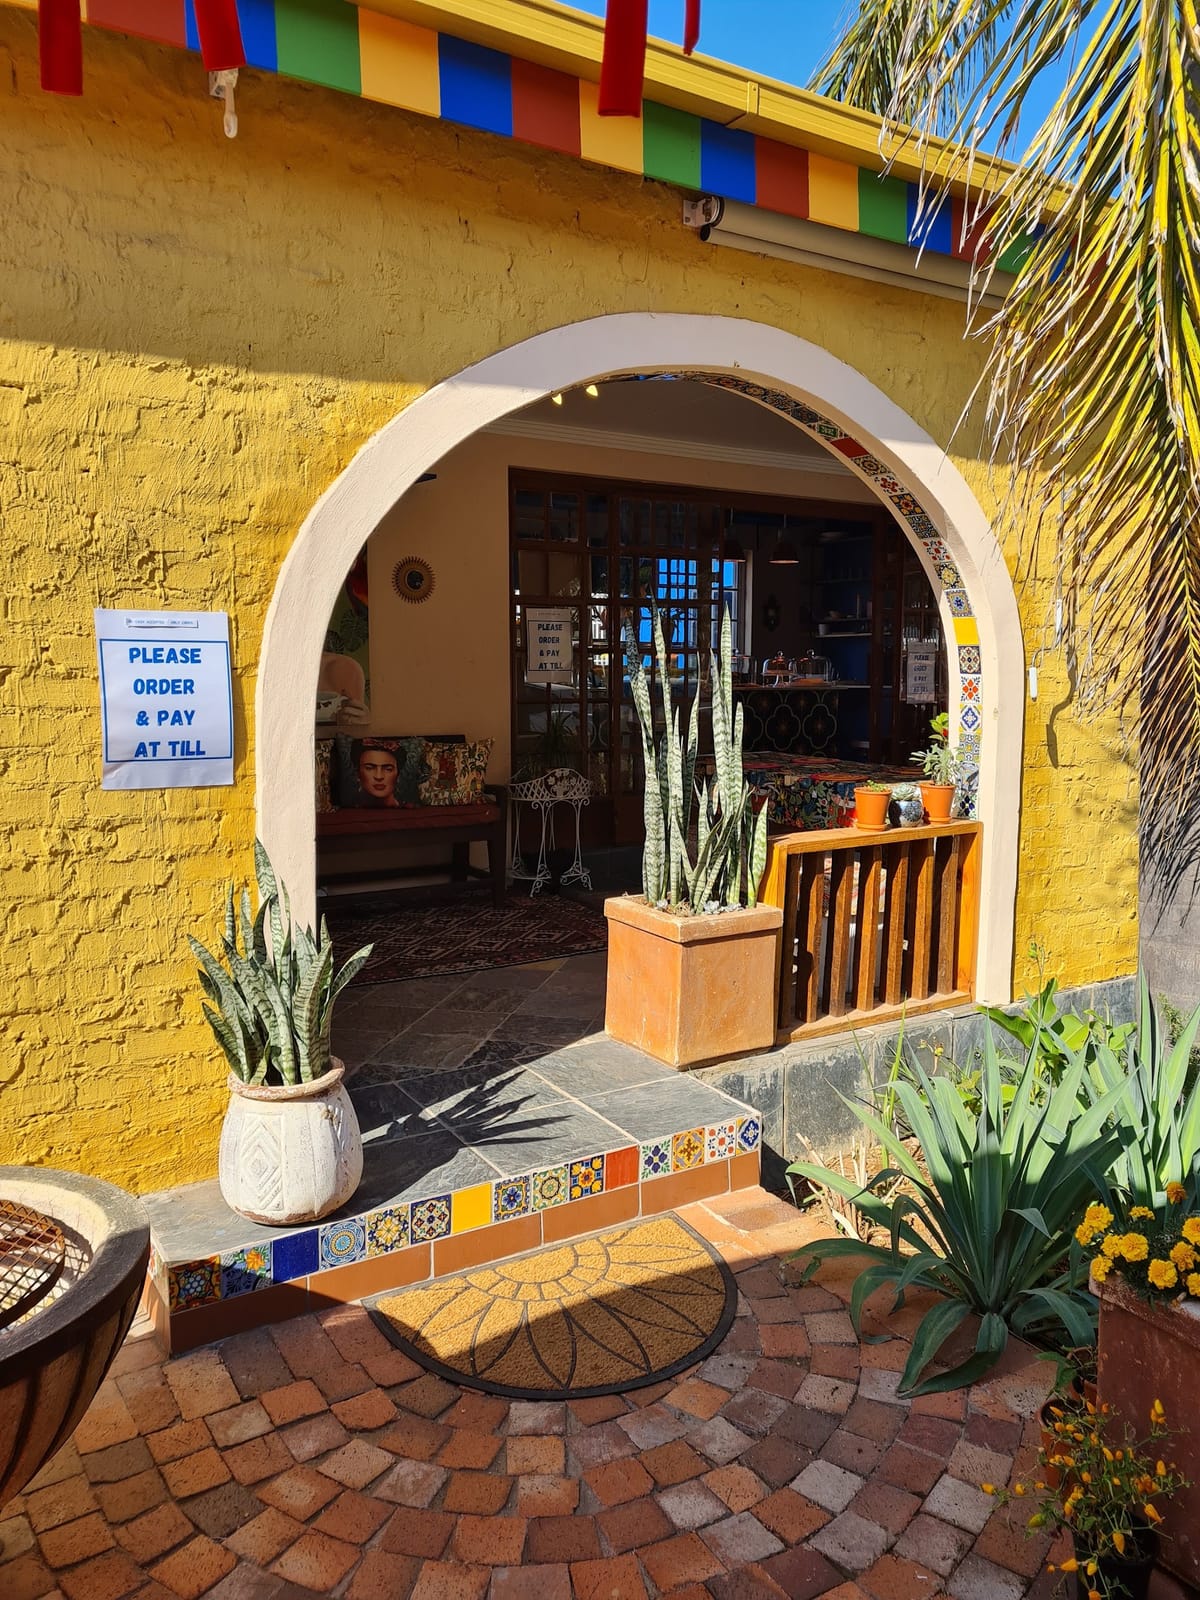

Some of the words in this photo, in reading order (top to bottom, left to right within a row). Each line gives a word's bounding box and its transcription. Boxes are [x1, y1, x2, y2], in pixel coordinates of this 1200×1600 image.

[537, 623, 563, 631] PLEASE
[538, 636, 560, 644] ORDER
[129, 647, 202, 664] PLEASE
[546, 649, 560, 657] PAY
[538, 662, 548, 670] AT
[133, 678, 195, 695] ORDER
[136, 710, 149, 726] &
[157, 710, 196, 726] PAY
[134, 741, 161, 758] AT
[168, 740, 206, 757] TILL
